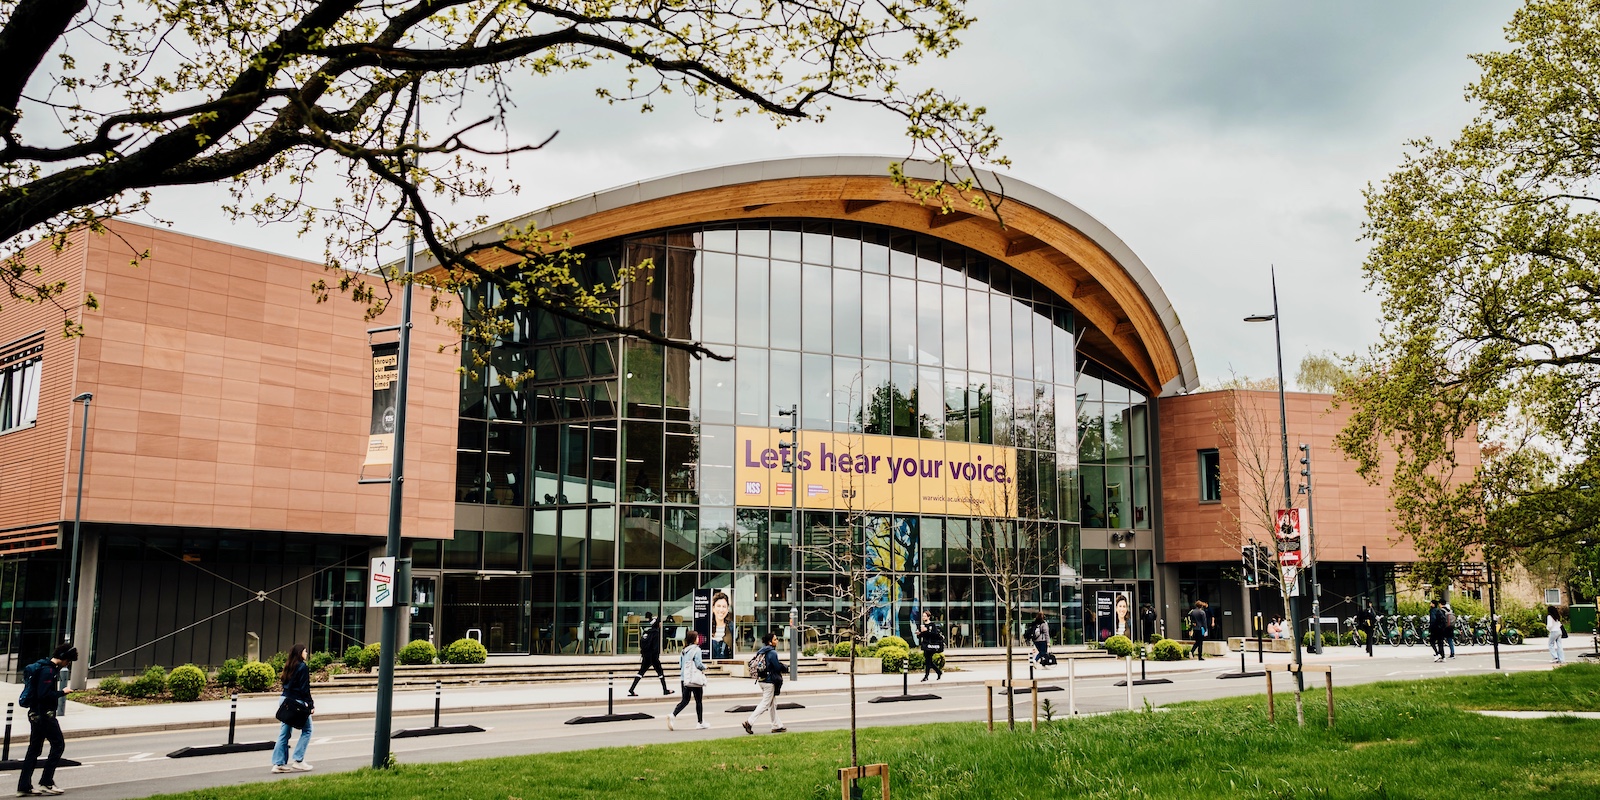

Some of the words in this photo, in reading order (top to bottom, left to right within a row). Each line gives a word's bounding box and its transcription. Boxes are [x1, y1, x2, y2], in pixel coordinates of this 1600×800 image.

[375, 357, 395, 365] through
[375, 371, 398, 381] changing
[745, 439, 812, 471] Lets
[820, 442, 881, 475] hear
[886, 454, 943, 484] your
[949, 455, 1012, 484] voice.
